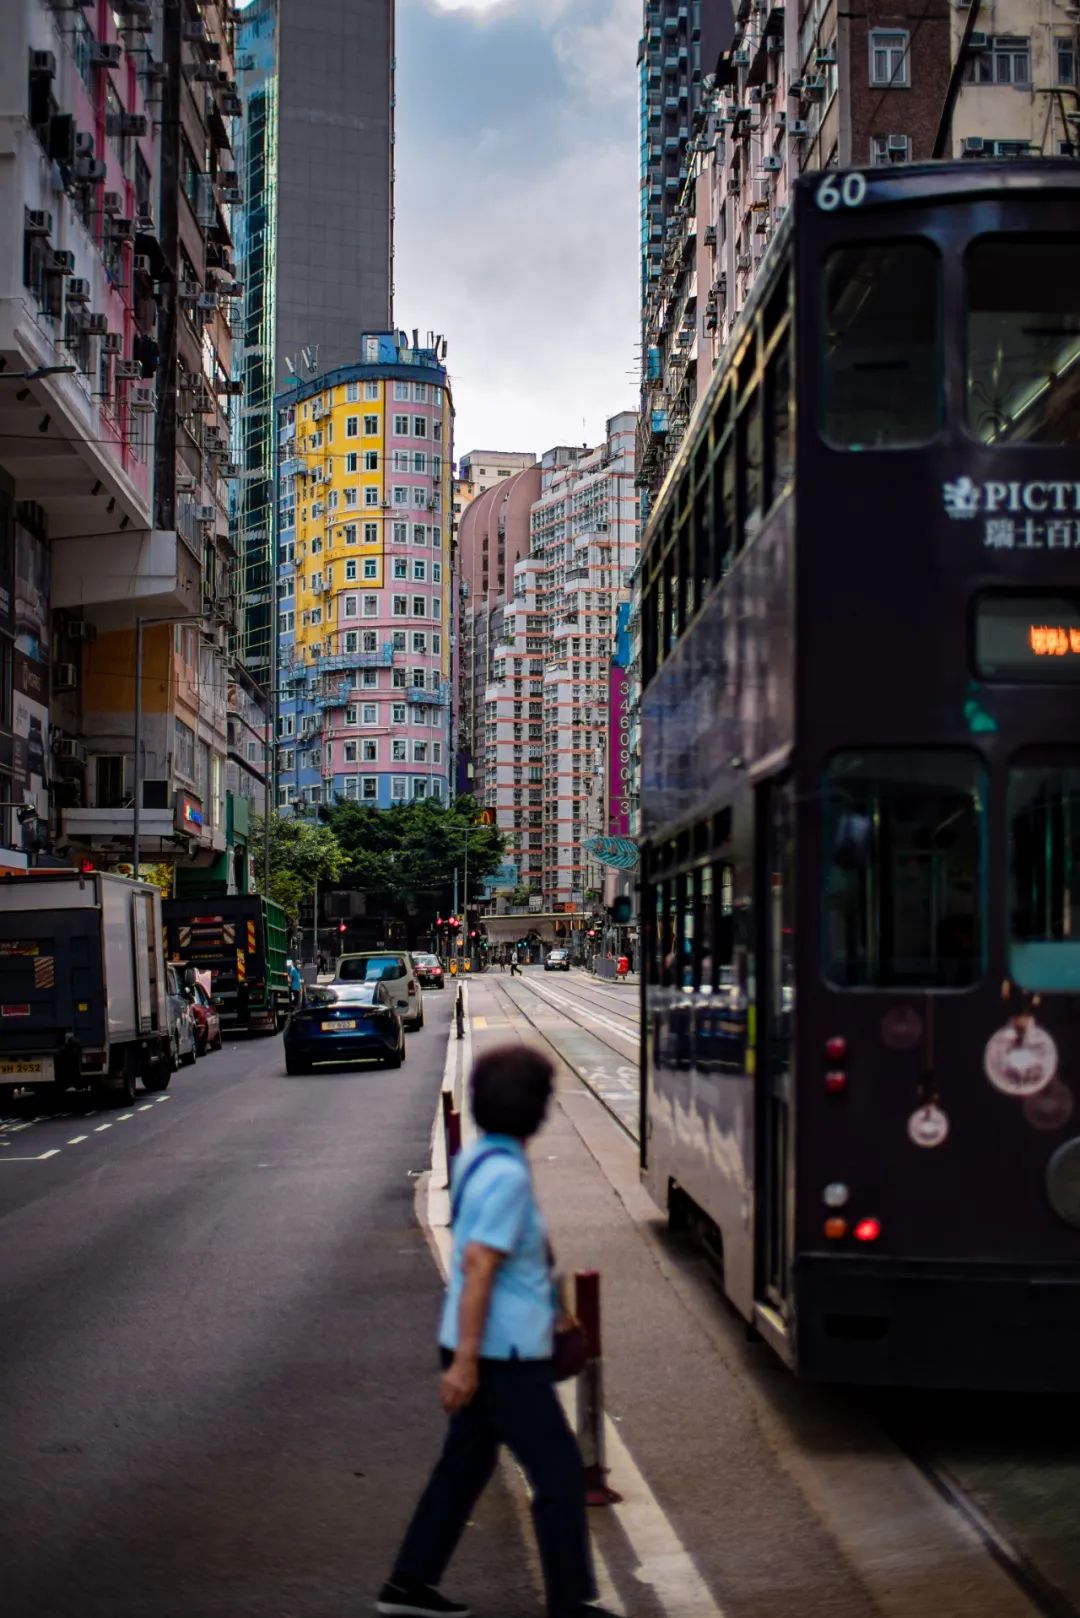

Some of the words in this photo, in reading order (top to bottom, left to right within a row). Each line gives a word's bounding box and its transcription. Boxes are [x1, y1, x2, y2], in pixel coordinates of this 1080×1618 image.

[816, 172, 867, 211] 60
[984, 481, 1080, 511] PICT
[984, 518, 1080, 549] 瑞士百
[619, 681, 630, 815] 34609013
